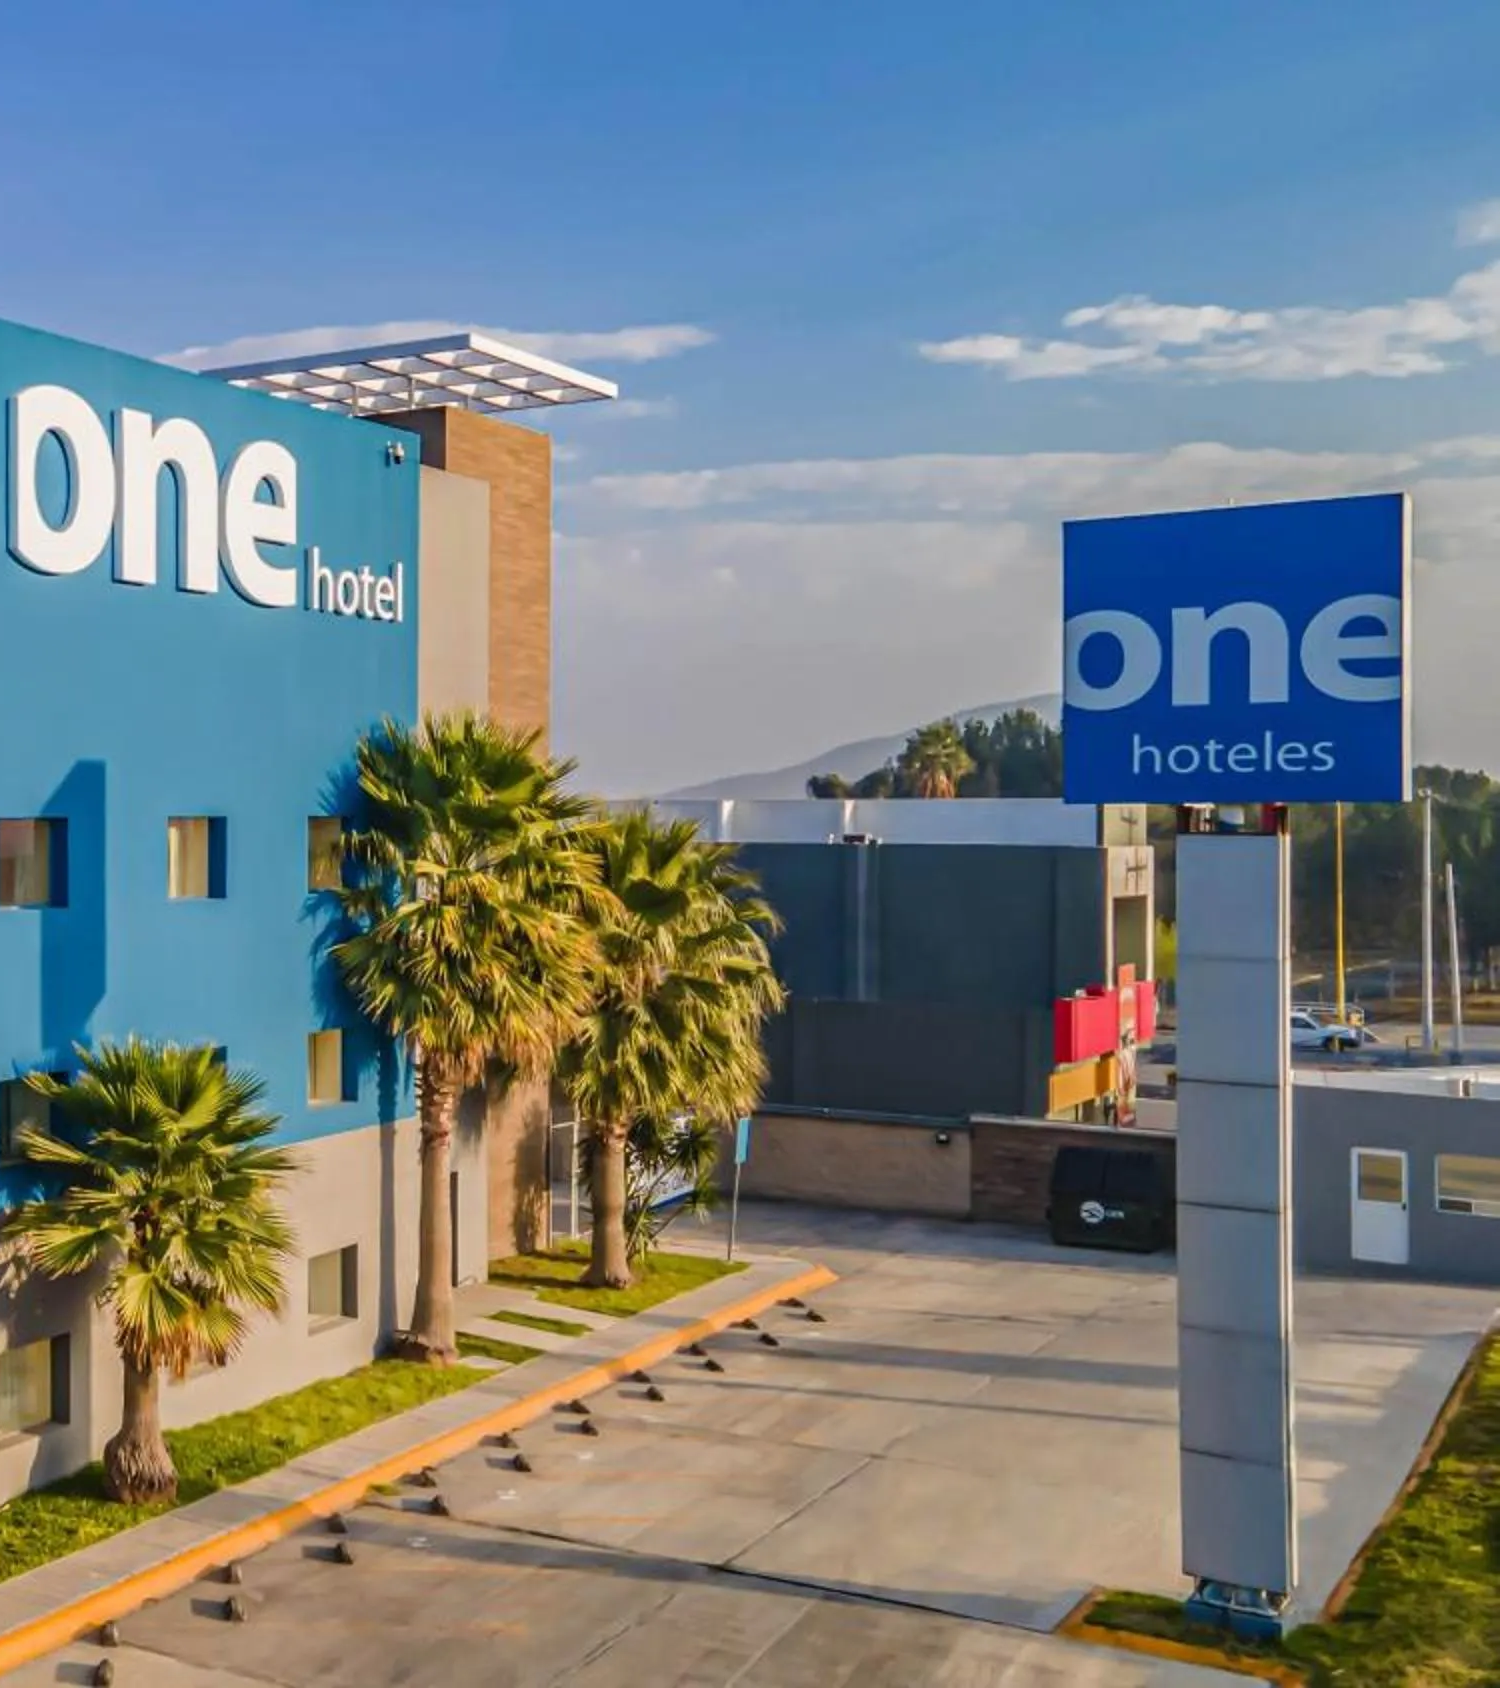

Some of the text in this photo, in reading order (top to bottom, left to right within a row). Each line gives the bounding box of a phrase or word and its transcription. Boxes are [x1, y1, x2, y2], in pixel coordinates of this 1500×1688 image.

[11, 384, 404, 622] one hotel
[1064, 594, 1402, 711] one
[1133, 730, 1335, 774] hoteles
